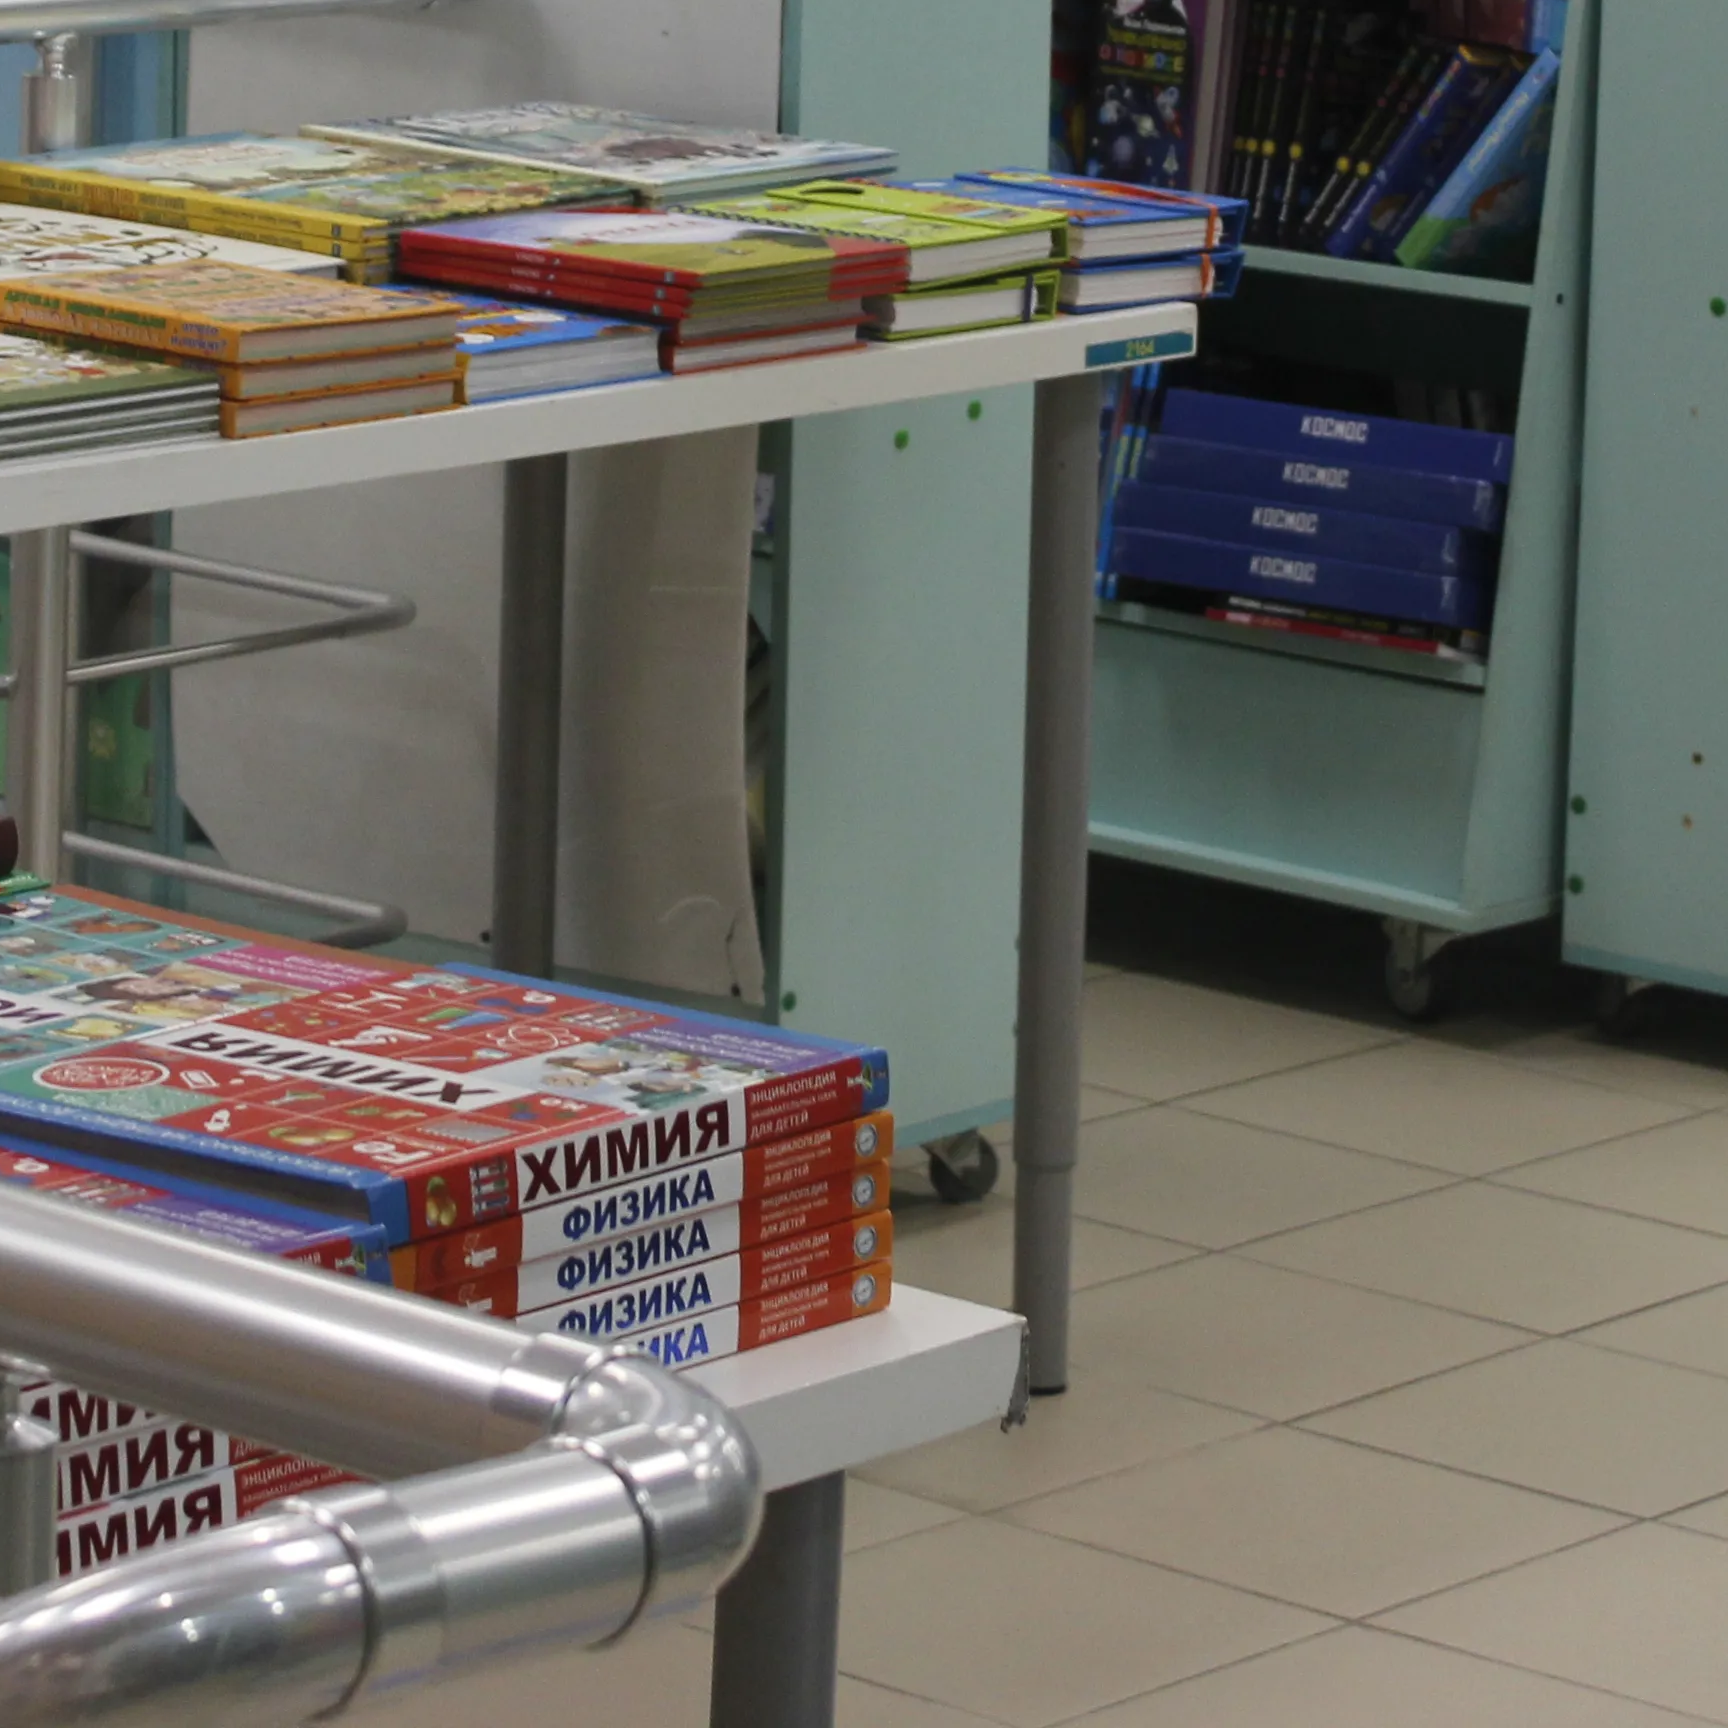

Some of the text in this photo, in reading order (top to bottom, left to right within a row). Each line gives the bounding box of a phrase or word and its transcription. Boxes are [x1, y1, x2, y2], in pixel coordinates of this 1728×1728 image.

[1300, 414, 1369, 444] КОСМОС
[1282, 461, 1350, 491] КОСМОС
[1251, 506, 1320, 535] КОСМОС
[1249, 554, 1317, 584] КОСМОС
[165, 1027, 494, 1106] ХИМИЯ
[750, 1071, 837, 1105] ЭНЦИКЛОПЕДИЯ
[749, 1110, 810, 1142] ДЛЯ ДЕТЕЙ
[520, 1100, 732, 1204] ХИМИЯ
[763, 1129, 833, 1159] ЭНЦИКЛОПЕДИЯ
[763, 1164, 810, 1189] ДЛЯ ДЕТЕЙ
[562, 1168, 716, 1241] ФИЗИКА
[760, 1215, 807, 1241] ДЛЯ ДЕТЕЙ
[555, 1217, 712, 1292] ФИЗИКА
[778, 1266, 808, 1286] ДЕТЕЙ
[557, 1270, 713, 1336] ФИЗИКА
[777, 1317, 806, 1336] ДЕТЕЙ
[57, 1425, 215, 1510] МИЯ
[57, 1483, 223, 1577] МИЯ
